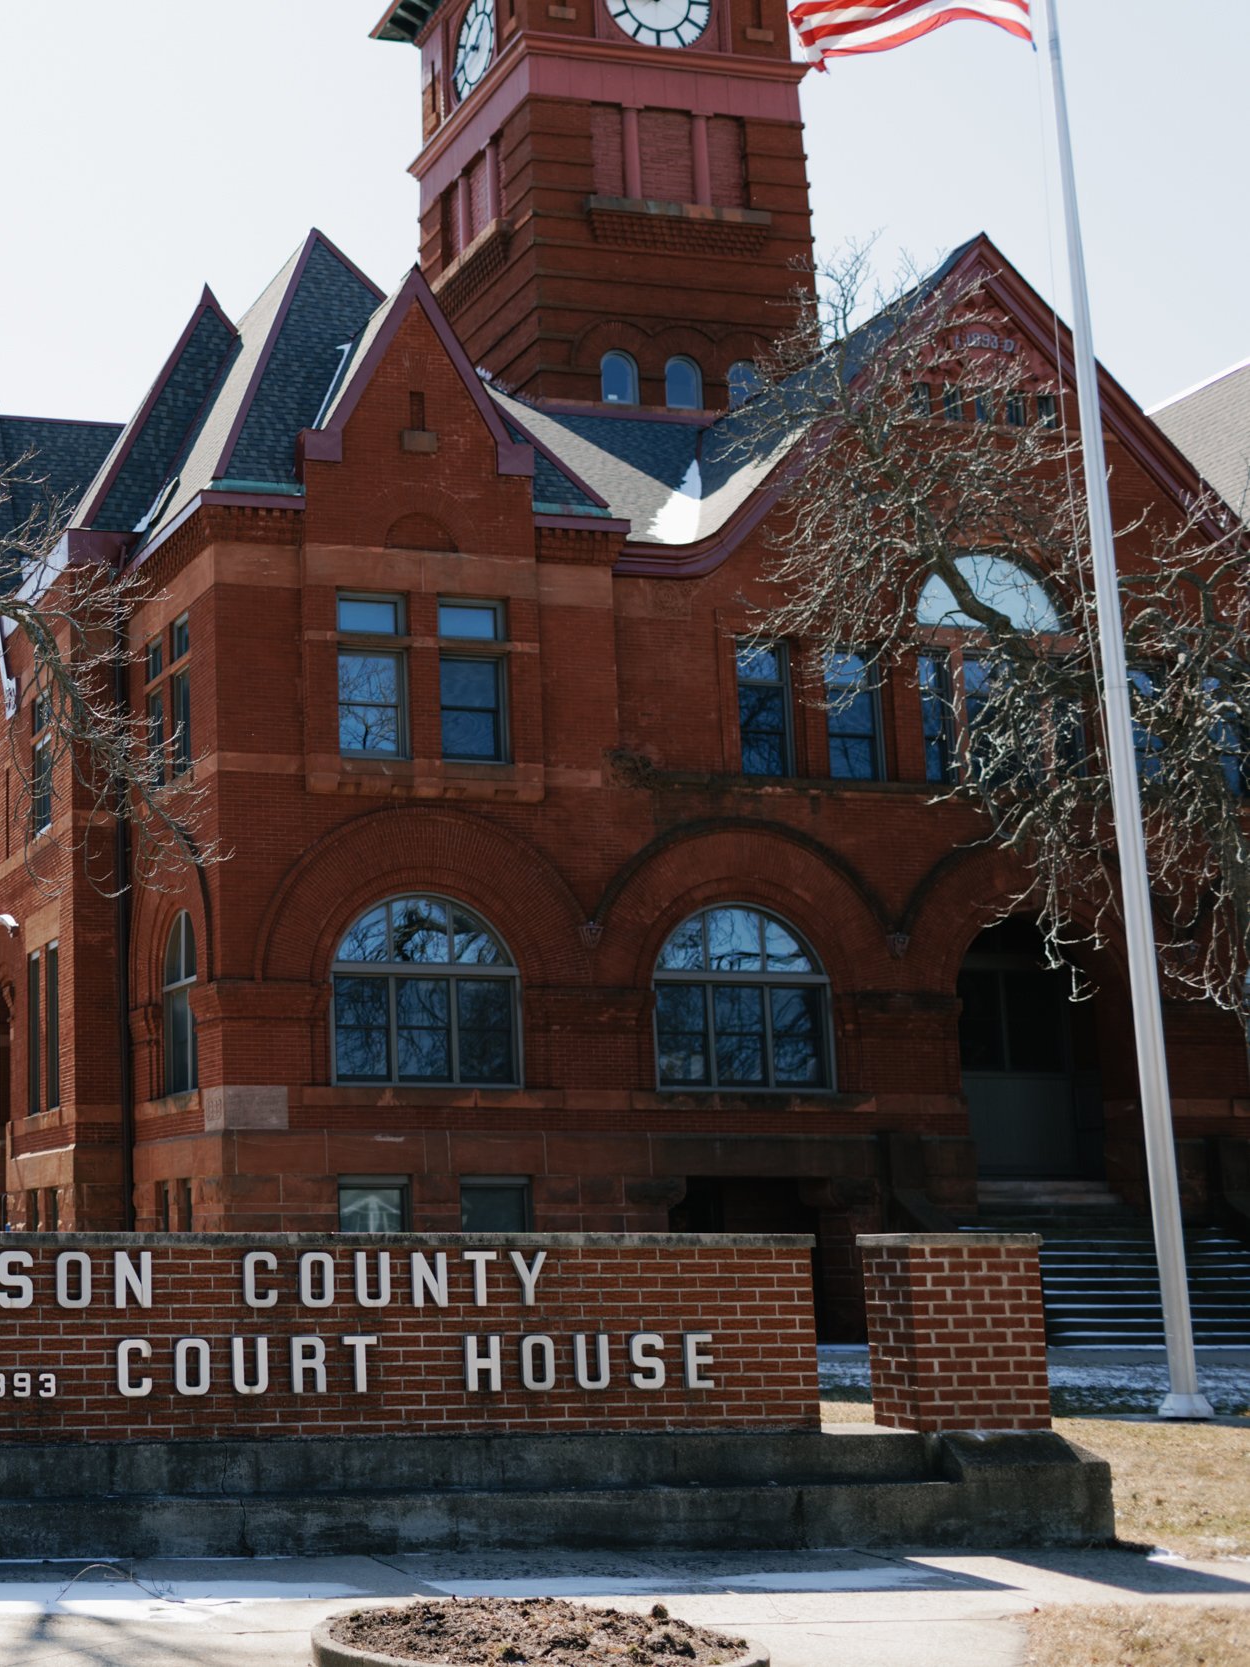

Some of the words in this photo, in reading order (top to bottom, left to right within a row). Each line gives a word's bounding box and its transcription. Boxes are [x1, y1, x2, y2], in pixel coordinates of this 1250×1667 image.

[967, 332, 999, 349] 1893
[1003, 338, 1015, 353] D
[242, 1251, 547, 1308] COUNTY
[116, 1335, 378, 1397] COURT
[464, 1333, 715, 1392] HOUSE
